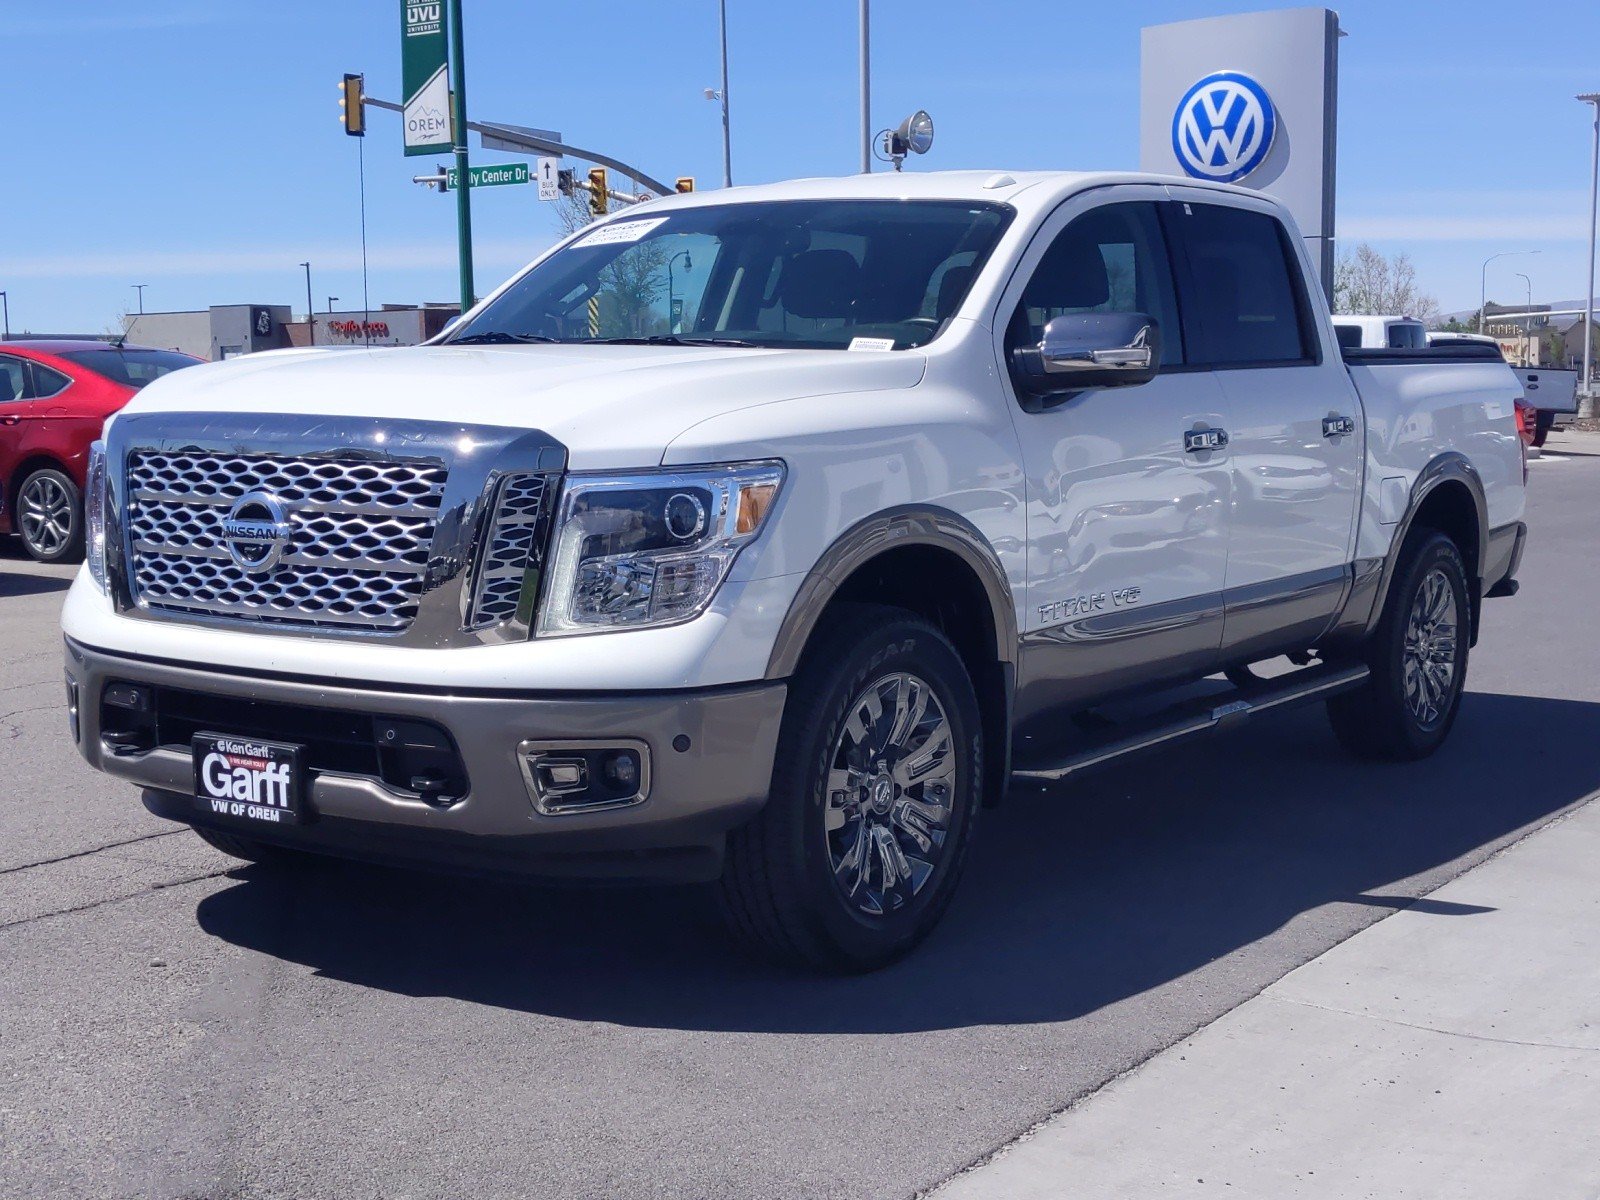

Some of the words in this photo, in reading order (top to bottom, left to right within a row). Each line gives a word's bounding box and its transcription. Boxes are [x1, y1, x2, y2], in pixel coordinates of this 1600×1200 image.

[407, 5, 440, 23] UVU
[407, 24, 440, 33] UNIVERSITY
[408, 118, 445, 132] OREM
[449, 172, 479, 186] Faly
[482, 169, 513, 183] Center
[515, 167, 527, 180] Dr
[540, 189, 556, 197] ONLY
[224, 525, 277, 540] NISSAN
[1038, 592, 1106, 624] TITAN
[1111, 586, 1141, 607] V8
[226, 741, 245, 755] Ken
[245, 744, 269, 758] Garff
[202, 752, 290, 808] Garff
[211, 799, 228, 813] VW
[230, 803, 245, 816] OF
[247, 806, 280, 822] OREM
